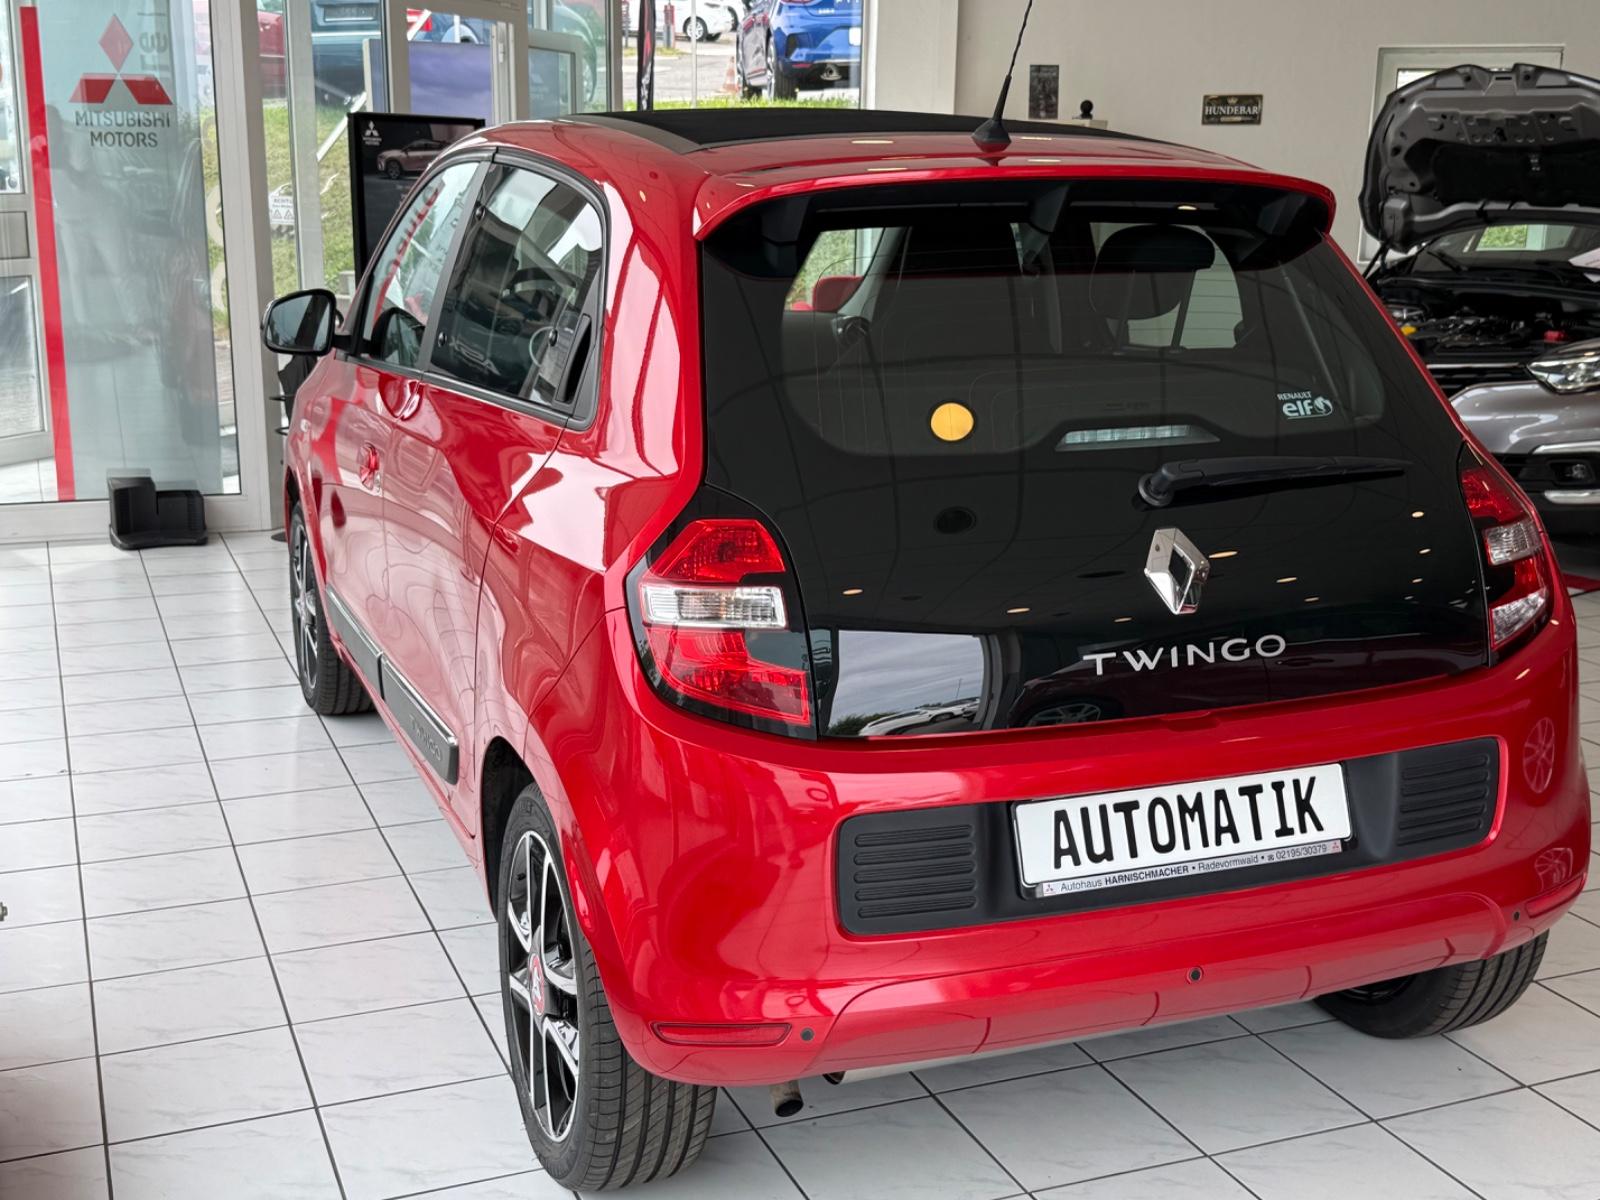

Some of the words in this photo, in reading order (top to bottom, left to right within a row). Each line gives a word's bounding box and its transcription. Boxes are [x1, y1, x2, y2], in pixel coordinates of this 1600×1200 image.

[1204, 105, 1259, 115] HUNDEBAR
[74, 110, 171, 128] MITSUBISHI
[90, 131, 158, 148] MOTORS
[1277, 390, 1312, 401] RENAULT
[1282, 400, 1313, 417] elf
[1083, 634, 1286, 676] TWINGO
[1053, 776, 1324, 870] AUTOMATIK
[1060, 879, 1102, 893] Autohaus
[1104, 865, 1190, 886] HARNISCHMACHER
[1198, 854, 1259, 872] Radevormwald
[1275, 843, 1328, 860] 02195/30379
